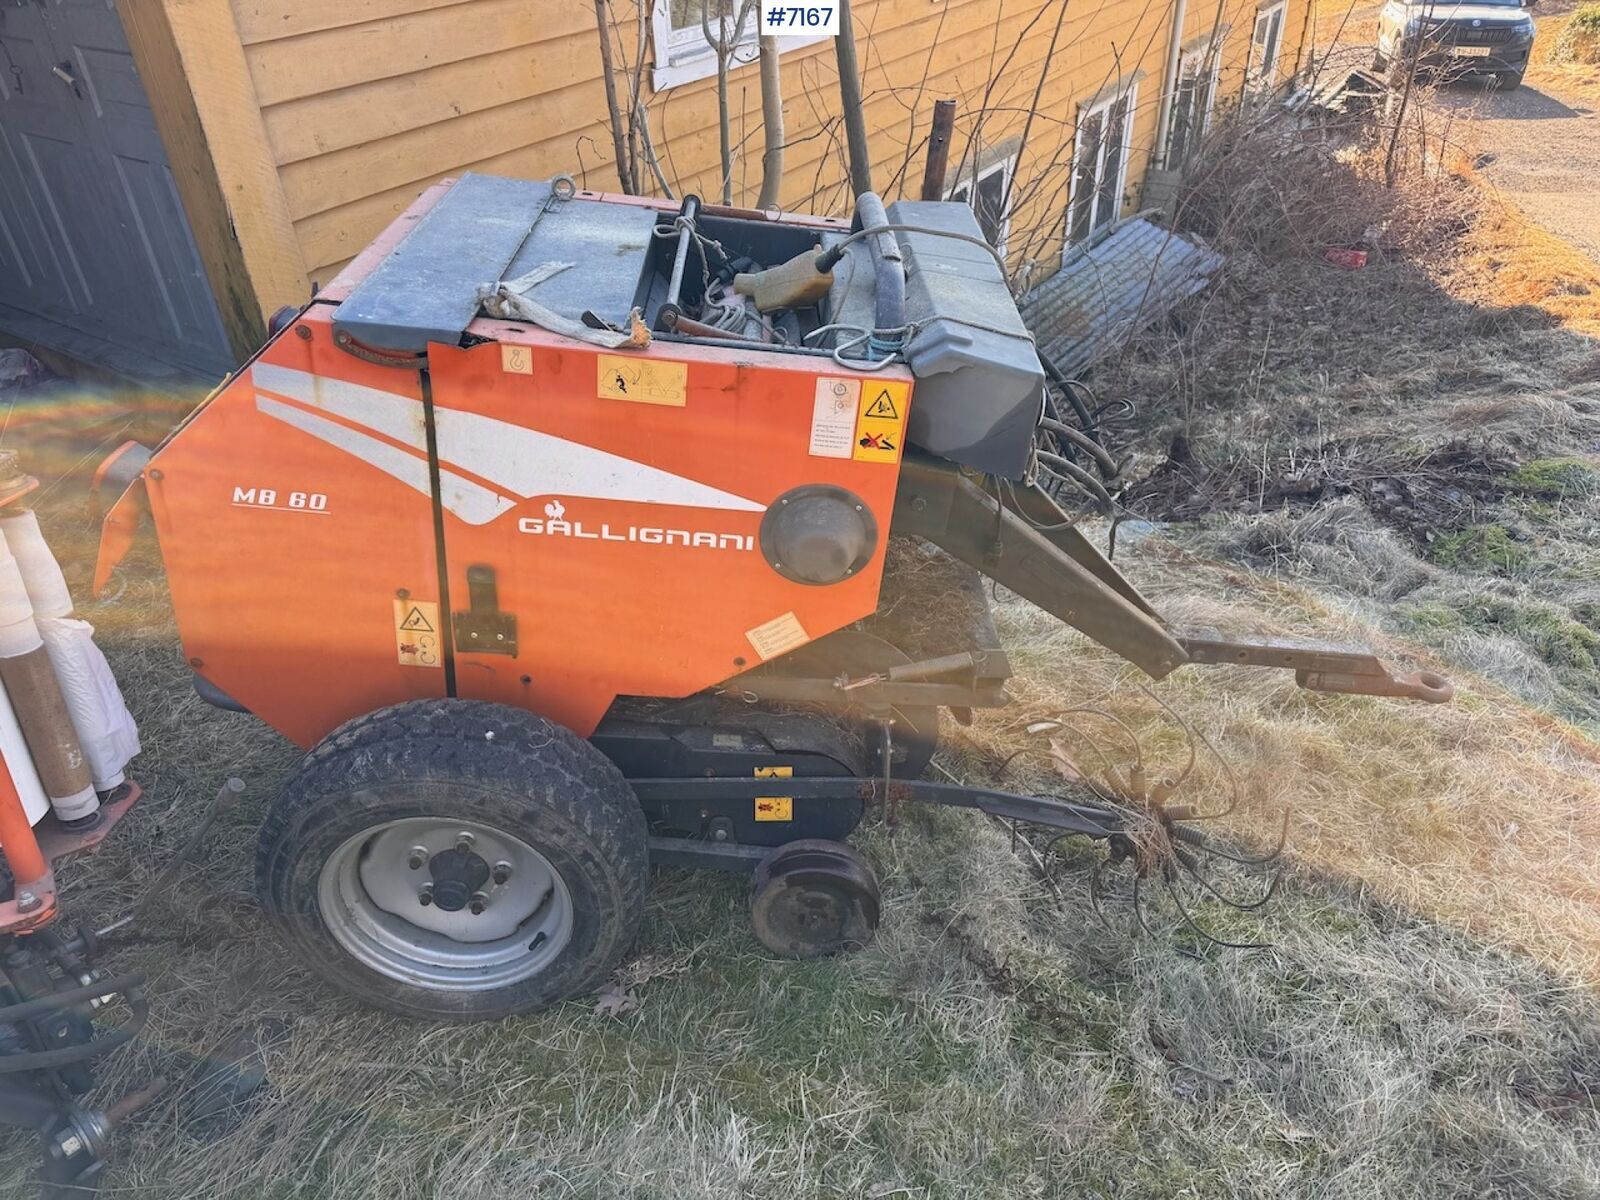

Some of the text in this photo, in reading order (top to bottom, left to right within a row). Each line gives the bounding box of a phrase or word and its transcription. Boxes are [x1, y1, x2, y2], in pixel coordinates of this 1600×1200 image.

[232, 486, 328, 510] MB 60
[518, 517, 754, 551] GALLIGNANI
